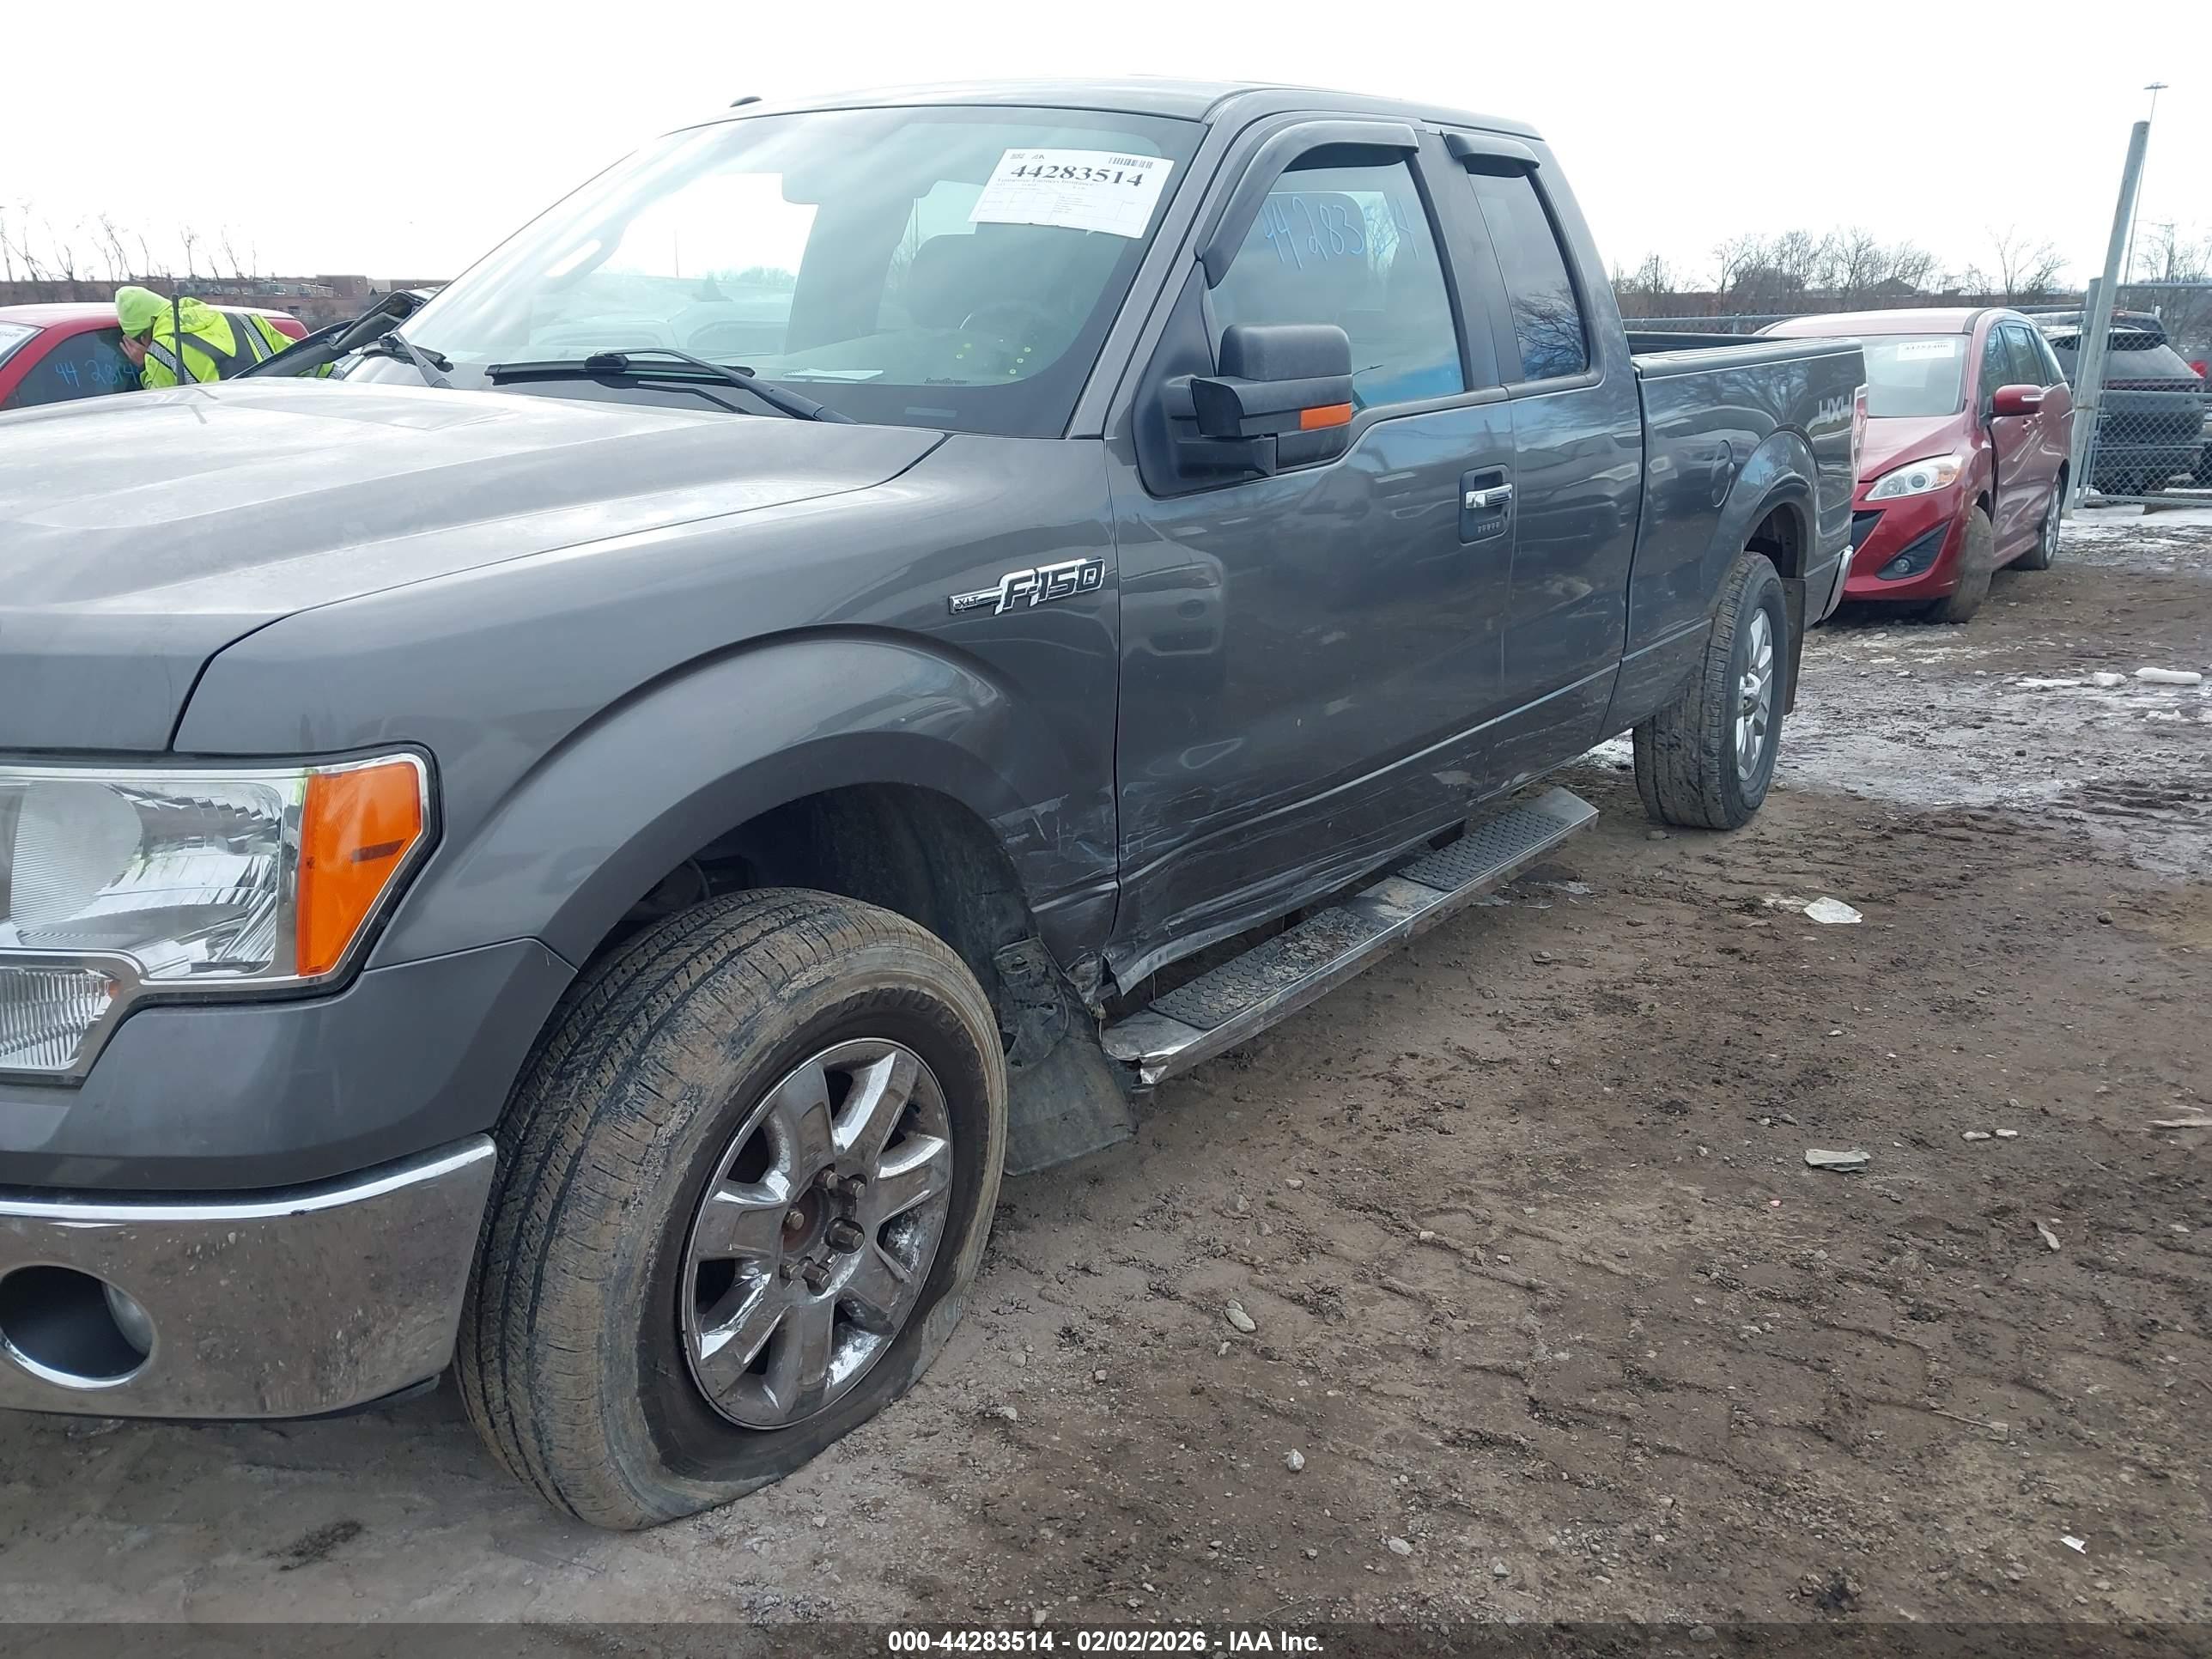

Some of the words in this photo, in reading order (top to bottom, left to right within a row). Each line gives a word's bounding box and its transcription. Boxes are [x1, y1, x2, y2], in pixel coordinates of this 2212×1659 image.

[1011, 164, 1142, 185] 44283514
[1262, 196, 1419, 270] 442834
[957, 596, 979, 607] XLT
